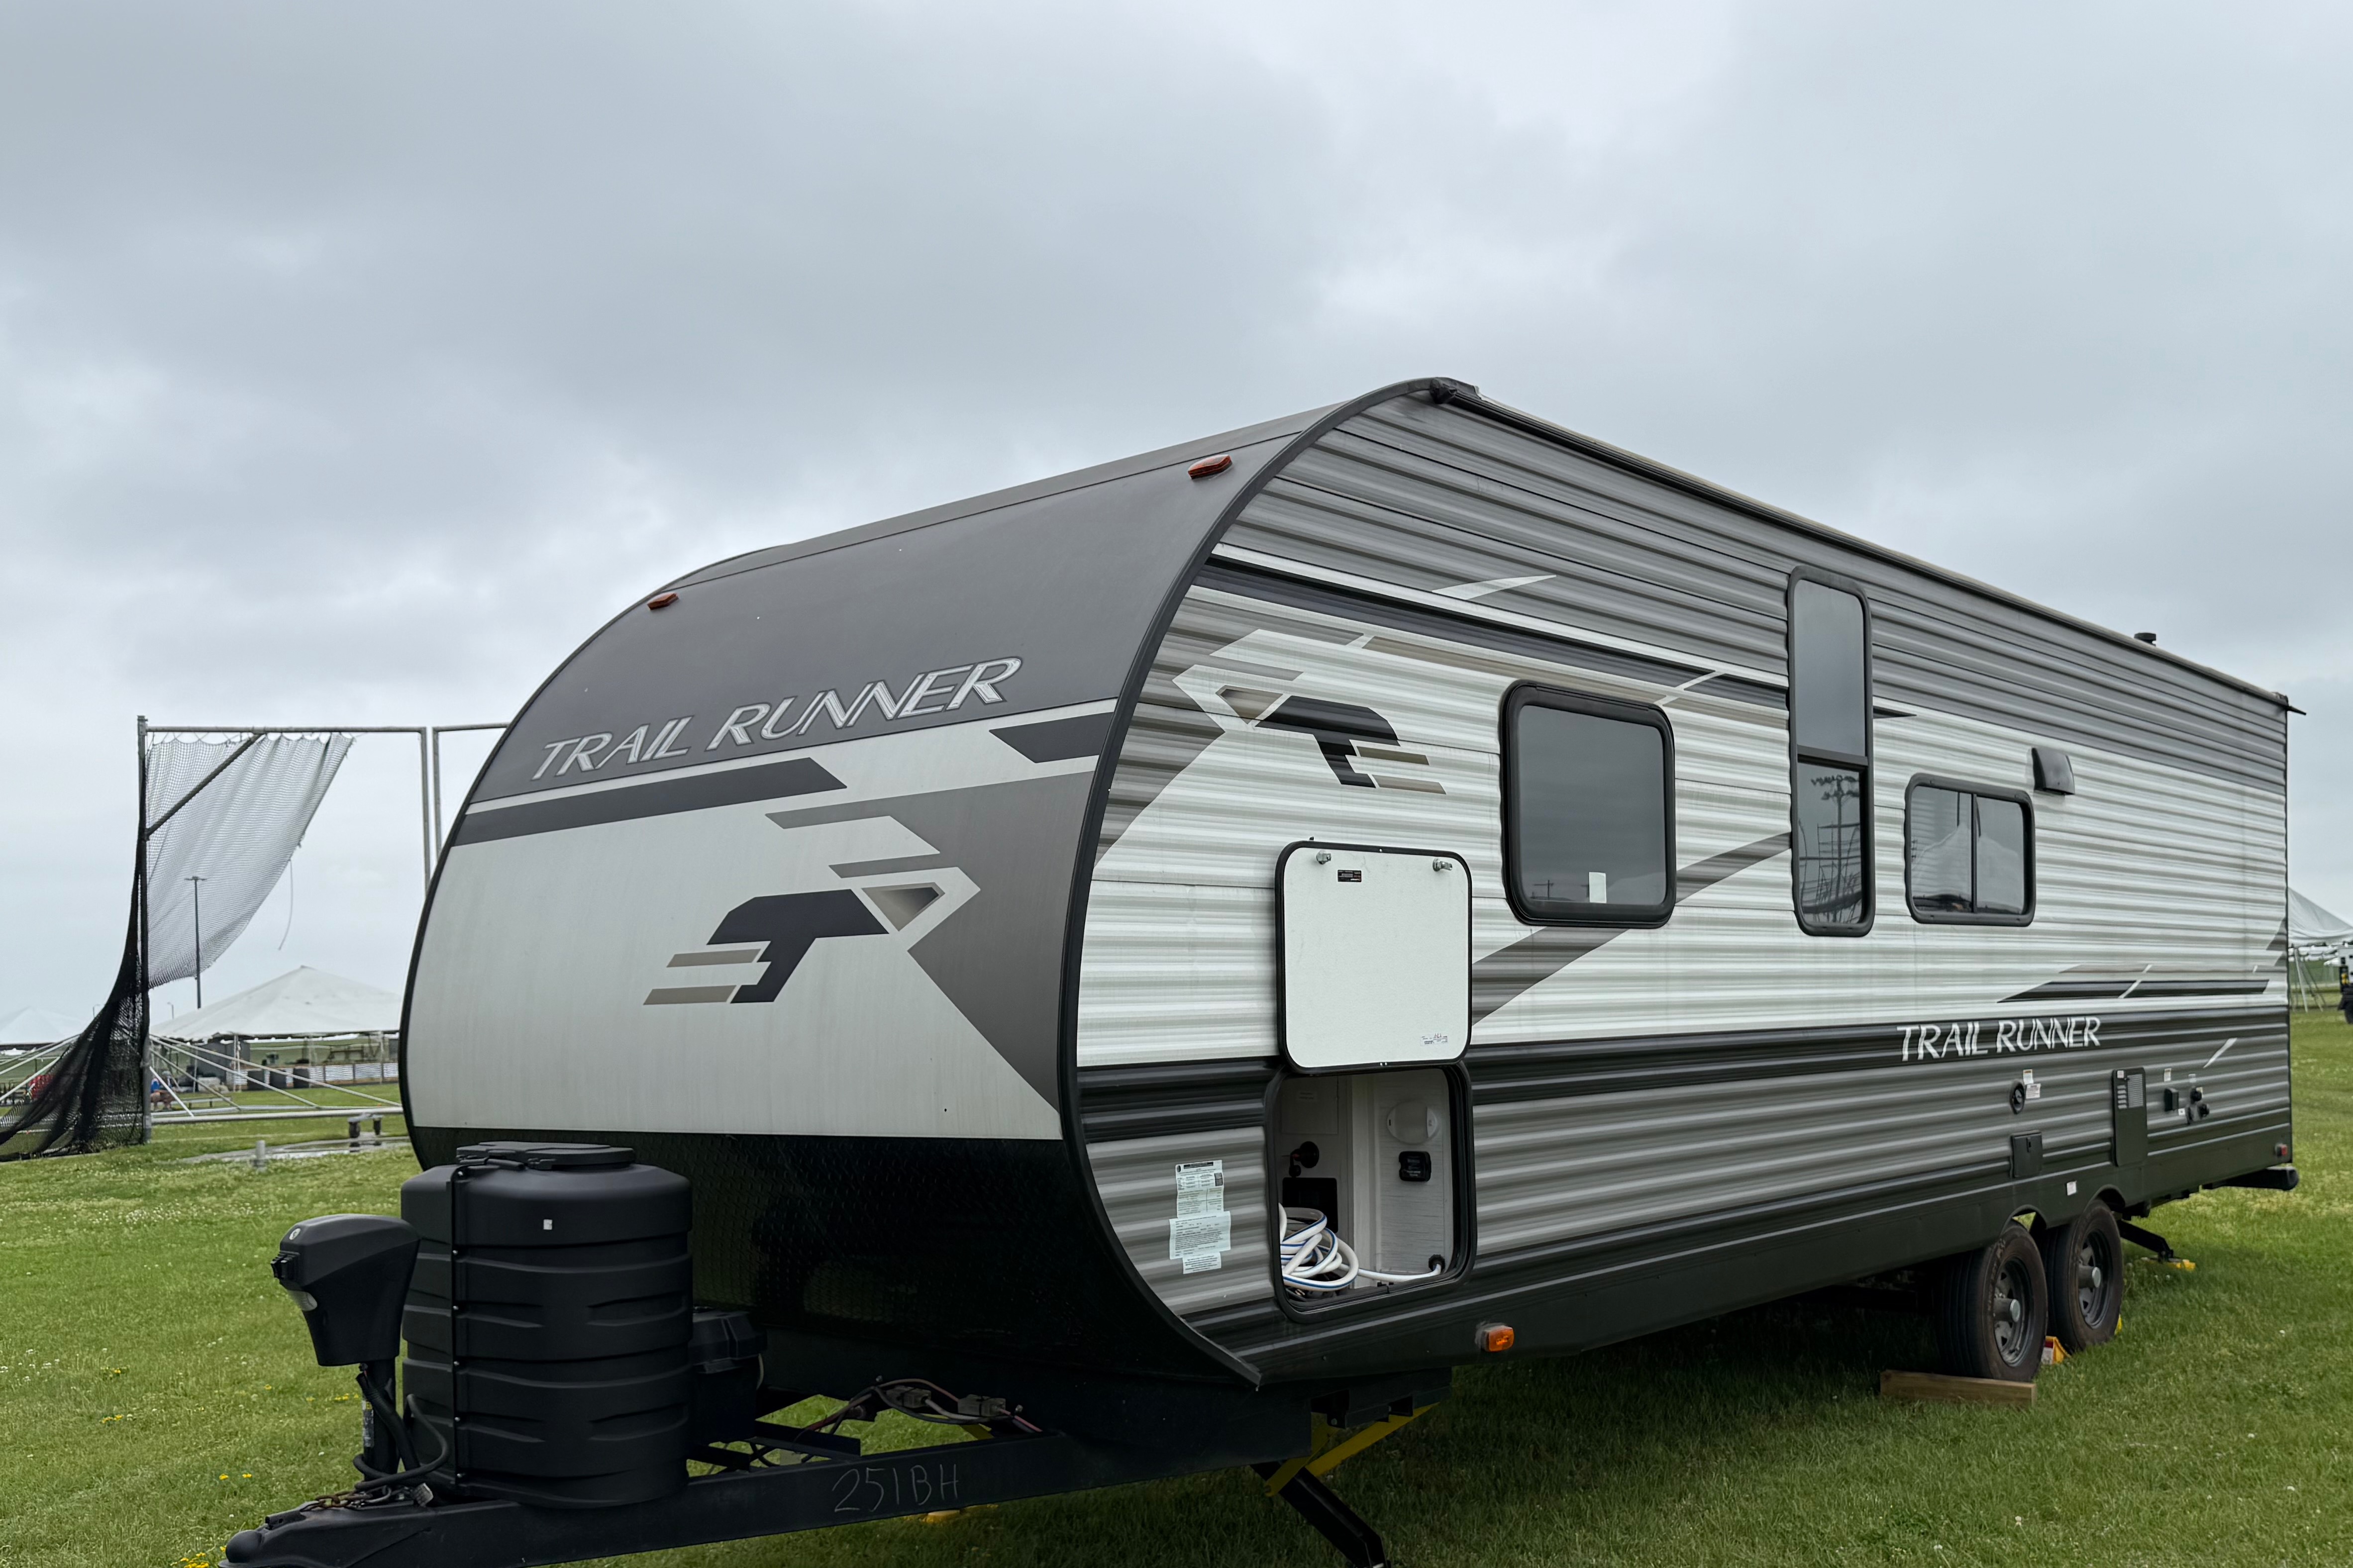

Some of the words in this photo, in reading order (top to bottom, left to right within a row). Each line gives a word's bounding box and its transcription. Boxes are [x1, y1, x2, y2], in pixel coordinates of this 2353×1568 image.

[531, 715, 694, 782] TRAIL
[705, 656, 1023, 752] RUNNER
[1897, 1021, 1988, 1062] TRAIL
[1996, 1016, 2101, 1053] RUNNER
